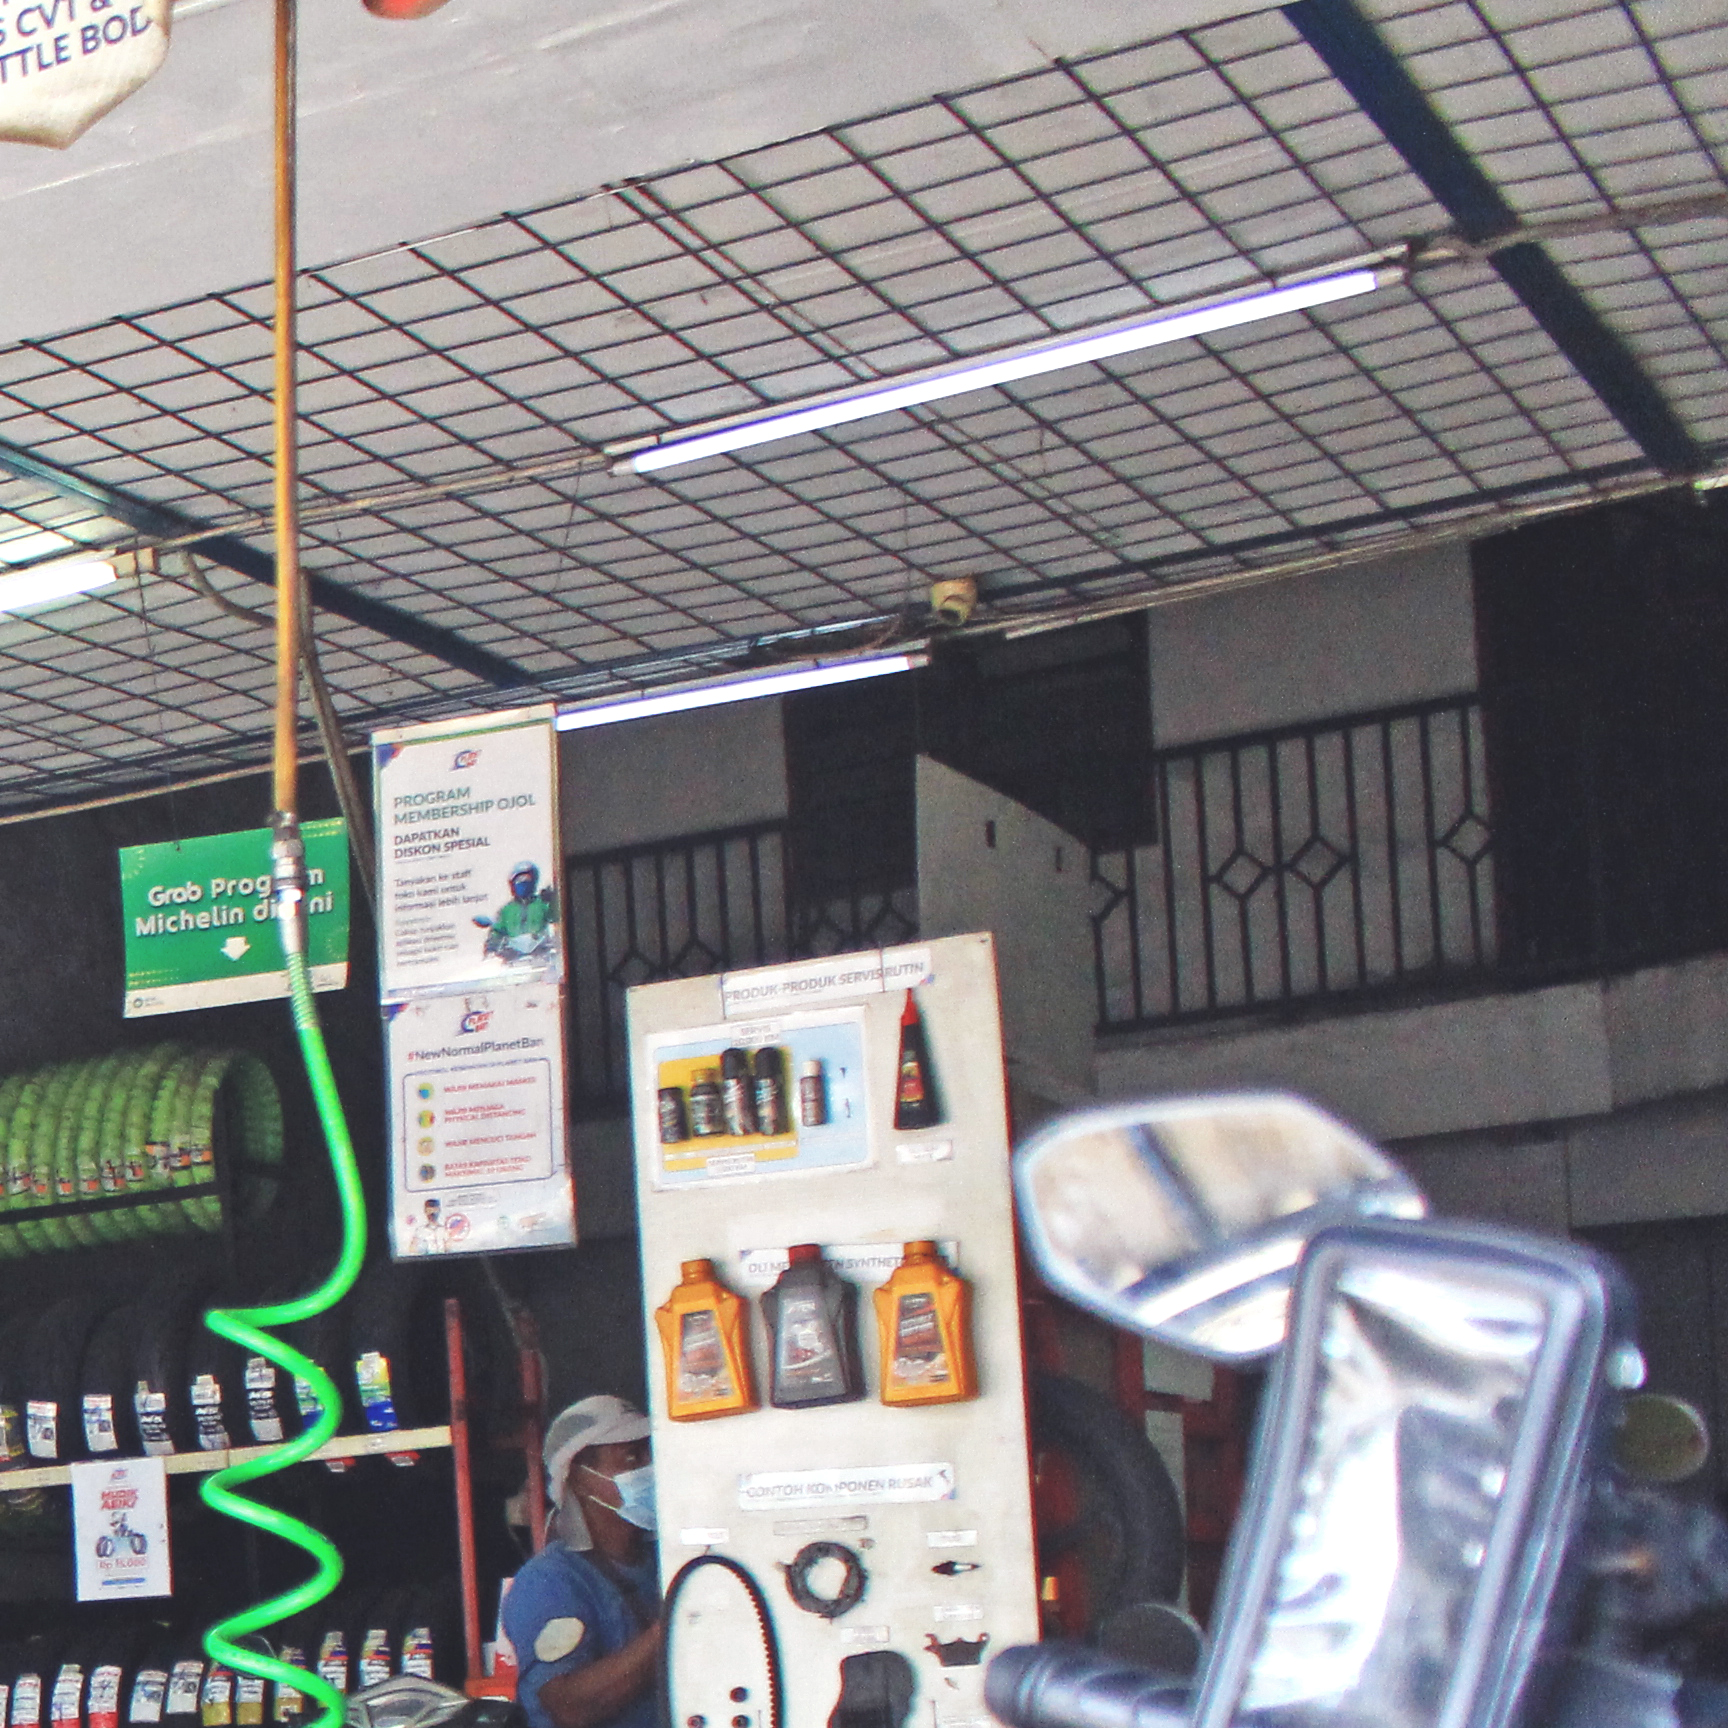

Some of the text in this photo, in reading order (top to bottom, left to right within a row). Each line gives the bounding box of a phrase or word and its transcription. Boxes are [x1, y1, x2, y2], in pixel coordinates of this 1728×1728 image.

[394, 787, 471, 809] PROGRAM
[394, 801, 494, 825] MEMBERSHIP
[394, 827, 460, 846] DAPATKAN
[394, 837, 491, 860] DISKON SPESIAL
[148, 881, 203, 907] Grab
[135, 906, 244, 937] Michelin
[725, 962, 924, 1002] PRODUK-PRODUK SERVIS RUTIN
[849, 1256, 903, 1270] SYNTHET
[748, 1484, 804, 1499] CONTOH
[888, 1476, 933, 1489] RUSAK
